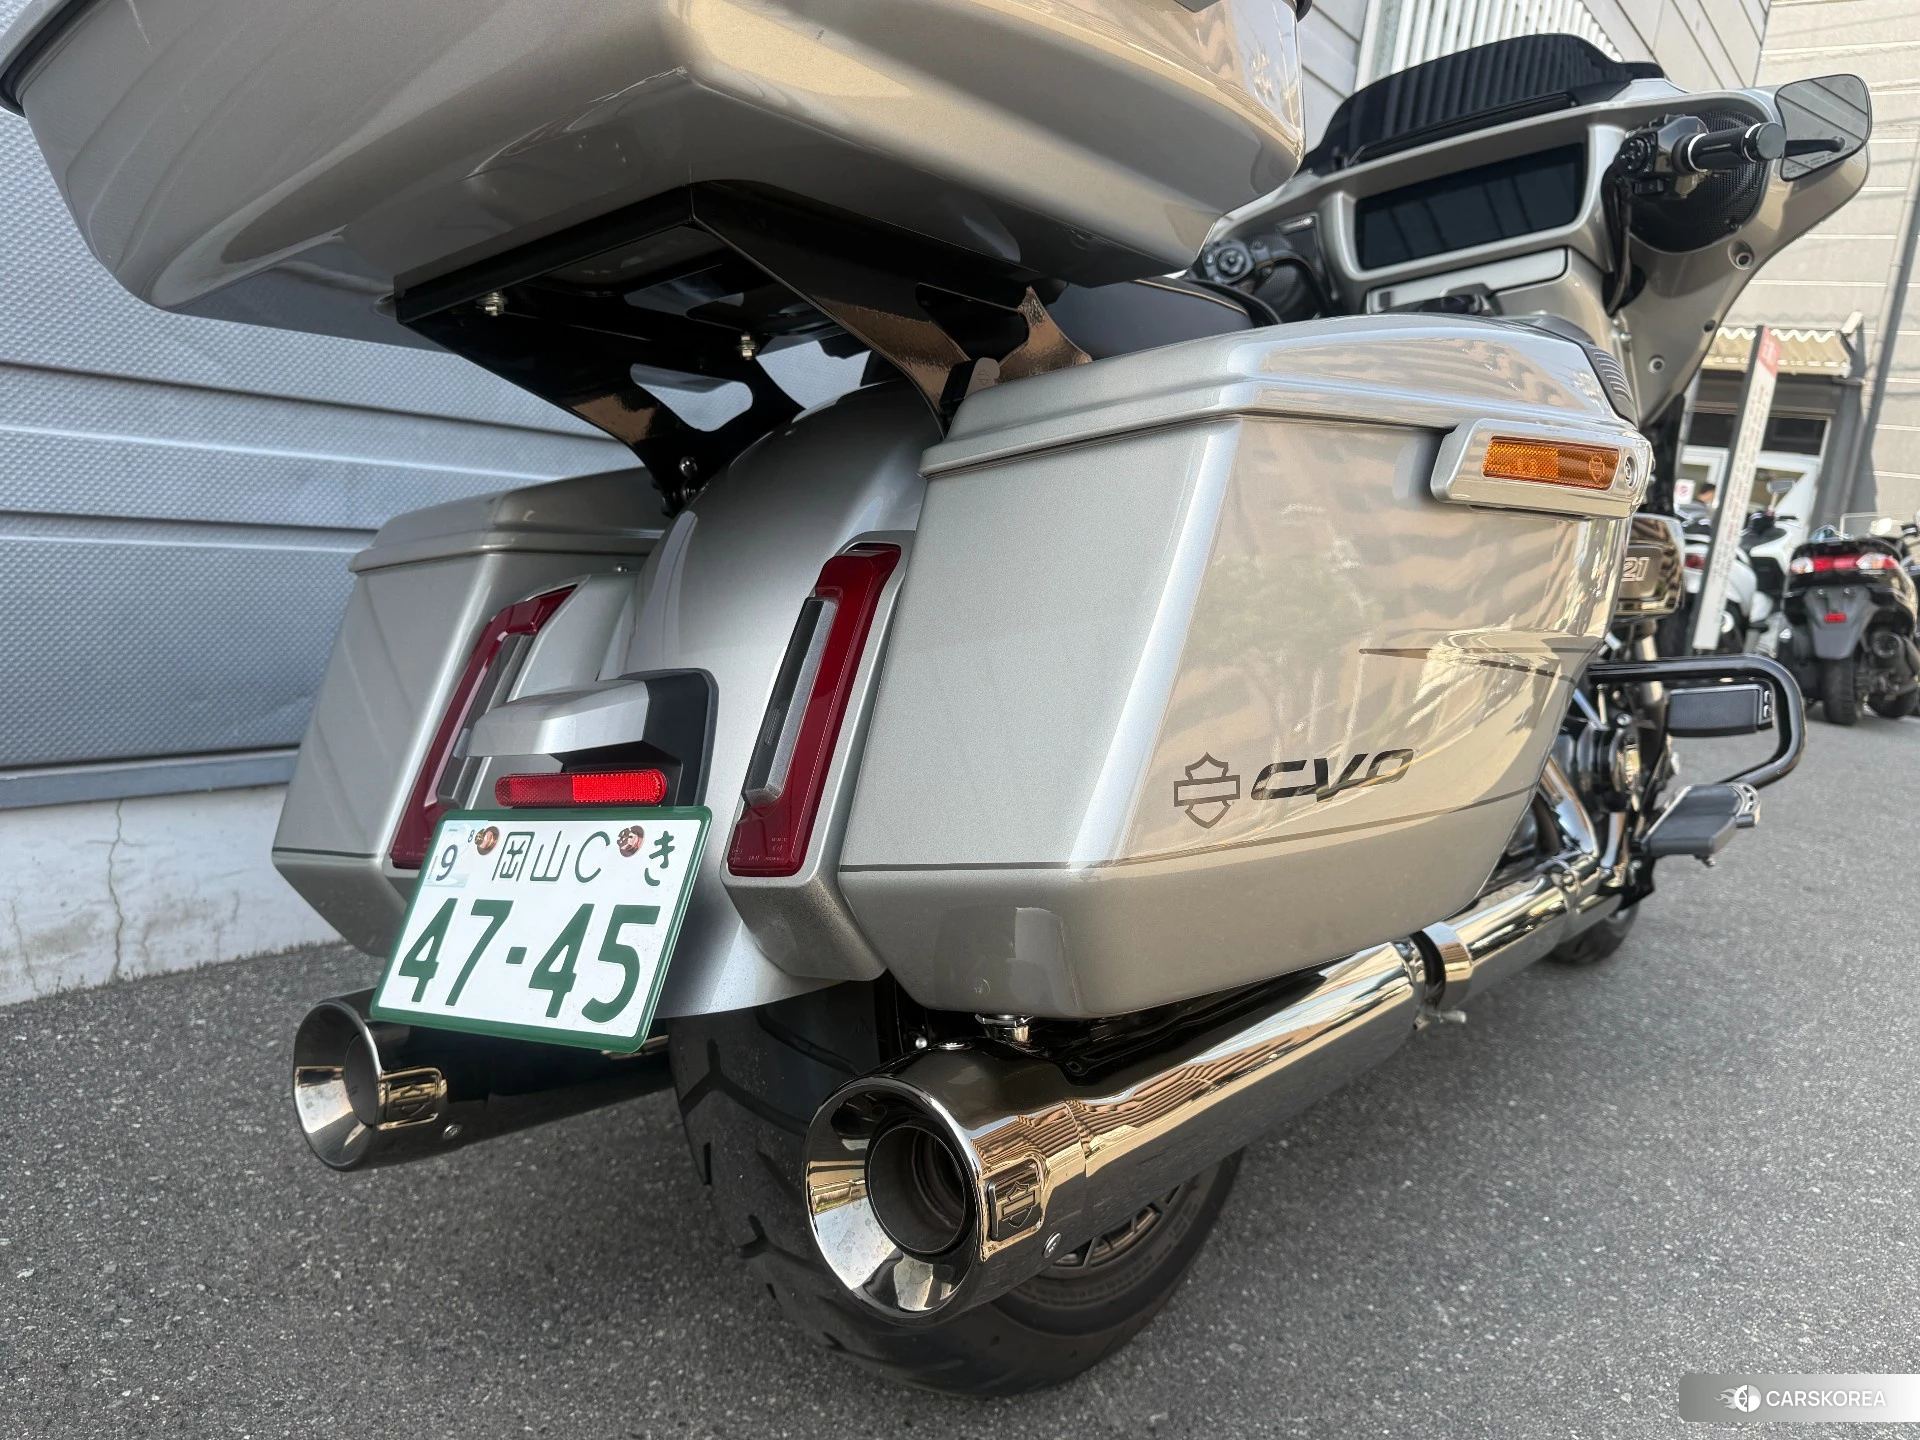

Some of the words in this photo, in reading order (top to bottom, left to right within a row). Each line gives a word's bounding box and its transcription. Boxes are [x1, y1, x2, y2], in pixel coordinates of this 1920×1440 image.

[1251, 748, 1414, 803] CVO
[436, 844, 458, 881] 9
[492, 830, 610, 883] 岡山C
[644, 830, 675, 887] き
